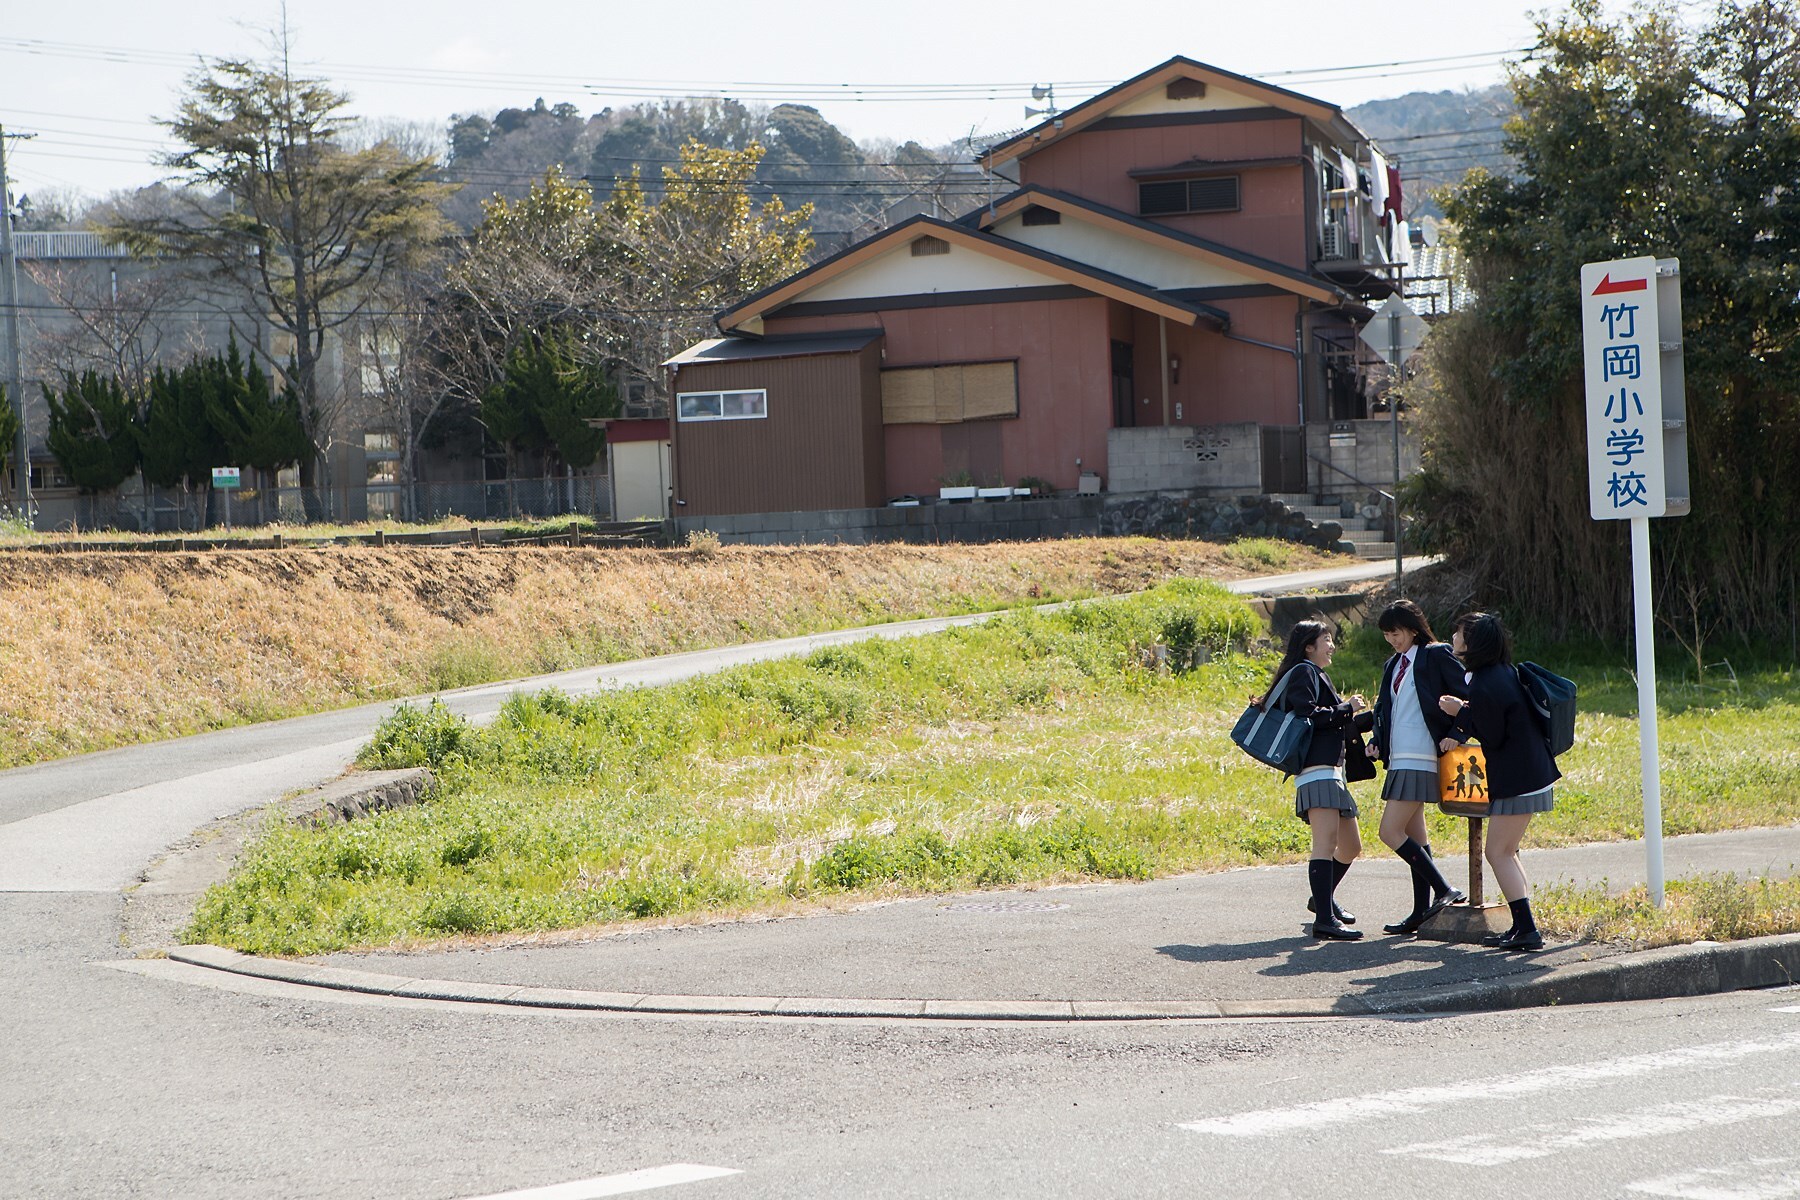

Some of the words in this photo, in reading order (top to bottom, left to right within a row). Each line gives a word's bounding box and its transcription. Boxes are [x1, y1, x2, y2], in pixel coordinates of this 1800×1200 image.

[1600, 302, 1648, 509] 竹岡小学校
